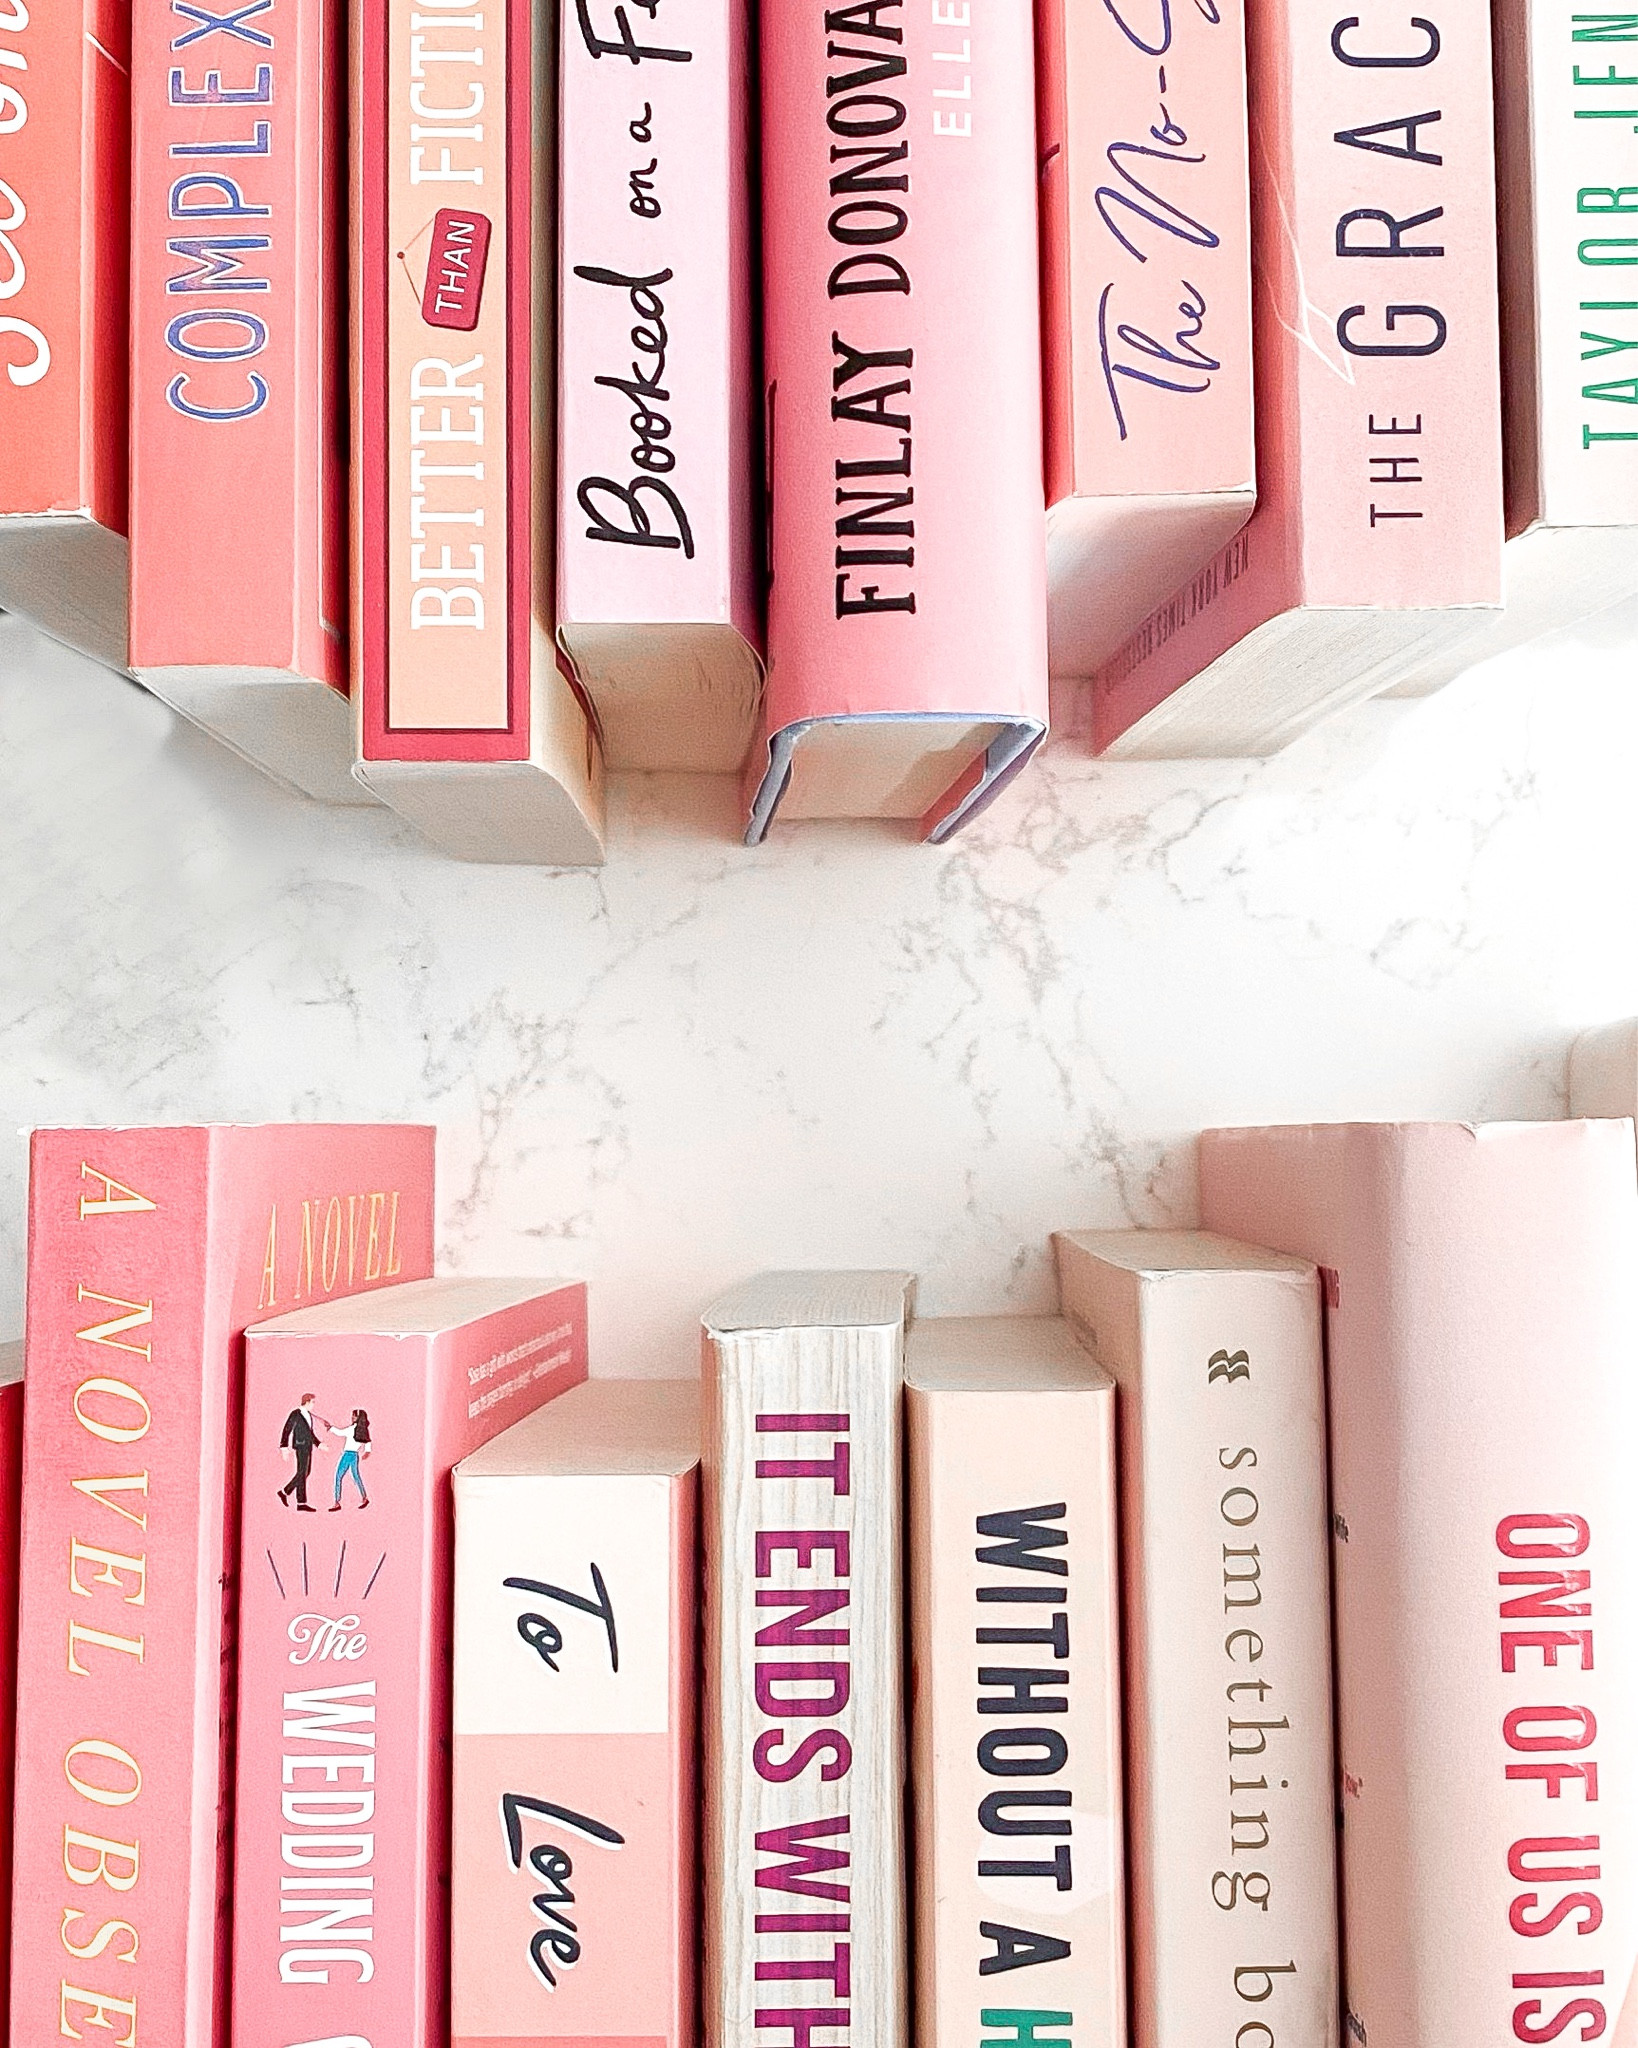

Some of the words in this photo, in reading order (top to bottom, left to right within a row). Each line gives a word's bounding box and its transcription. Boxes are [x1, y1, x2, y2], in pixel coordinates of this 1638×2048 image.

[410, 0, 484, 185] FICTI
[575, 0, 692, 65] F
[932, 0, 972, 137] ELLE
[629, 102, 653, 142] a
[630, 158, 658, 219] on
[824, 0, 911, 299] DONOVA
[1331, 16, 1448, 356] GRAC
[164, 0, 275, 423] COMPLEX
[434, 219, 475, 315] THAN
[574, 266, 694, 559] Booked
[1098, 280, 1220, 440] The
[410, 354, 485, 630] BETTER
[832, 330, 916, 620] FINLAY
[1368, 413, 1423, 527] THE
[79, 1163, 157, 1221] A
[256, 1204, 278, 1311] A
[295, 1191, 402, 1300] NOVEL
[67, 1284, 157, 1677] NOVEL
[753, 1412, 851, 1497] IT
[286, 1612, 368, 1667] The
[503, 1562, 619, 1674] To
[752, 1530, 853, 1784] ENDS
[1495, 1513, 1597, 1673] ONE
[974, 1502, 1073, 1893] WITHOUT
[1211, 1447, 1291, 1913] something
[1503, 1706, 1599, 1803] OF
[59, 1739, 143, 2048] OBSE
[277, 1680, 377, 1985] WEDDING
[502, 1793, 627, 1992] Love
[1507, 1834, 1605, 1938] US
[978, 1920, 1072, 1976] A
[1511, 1970, 1608, 2045] IS
